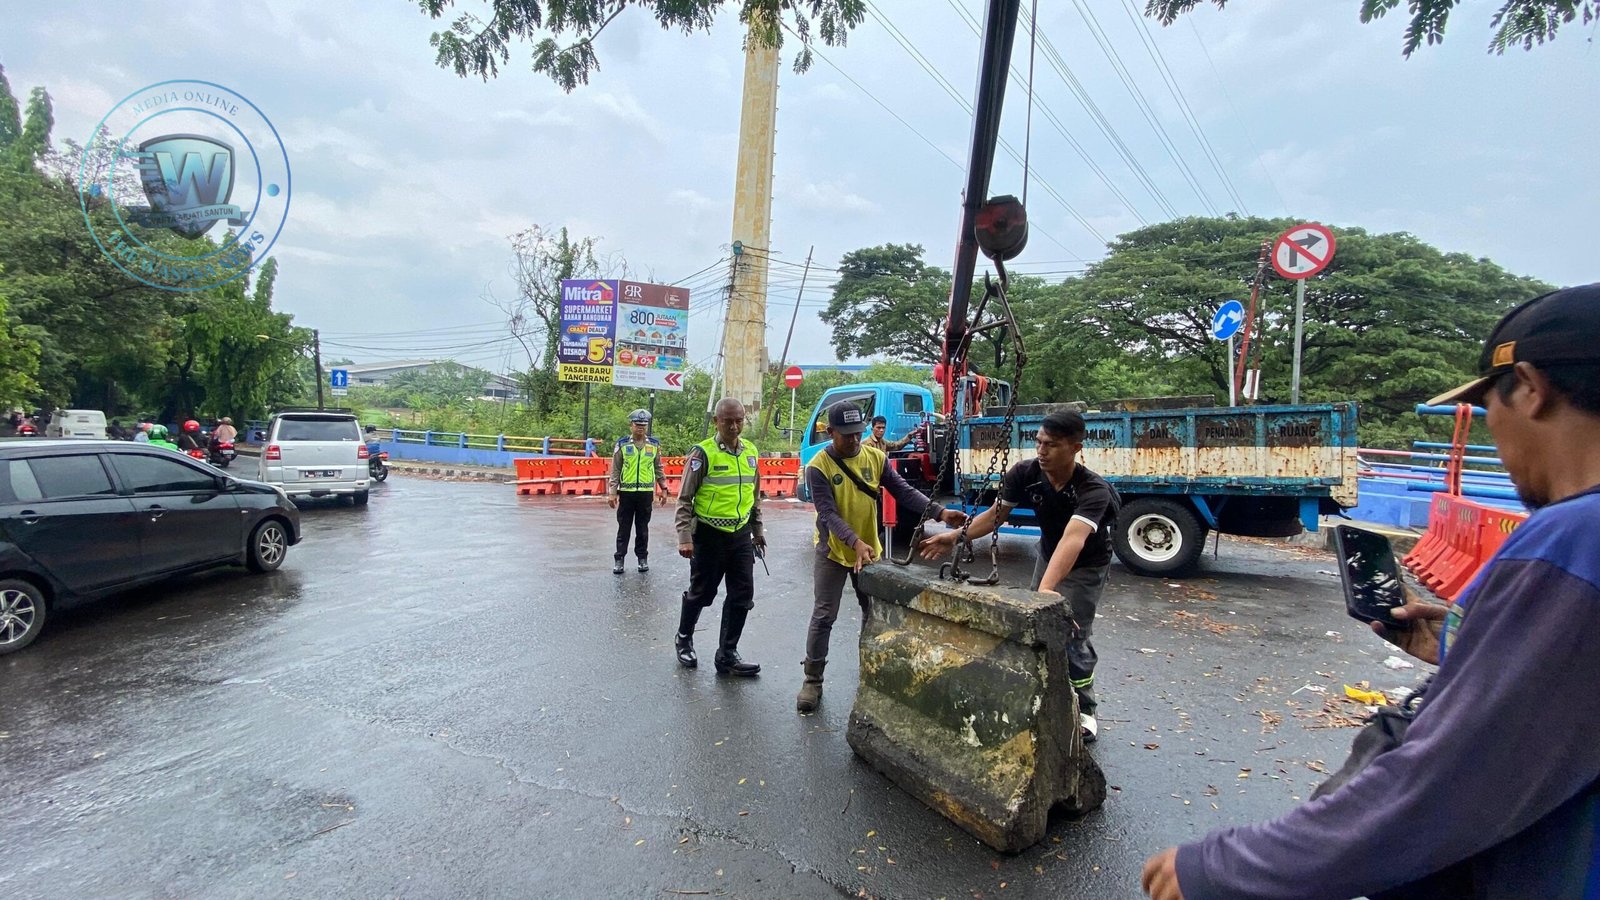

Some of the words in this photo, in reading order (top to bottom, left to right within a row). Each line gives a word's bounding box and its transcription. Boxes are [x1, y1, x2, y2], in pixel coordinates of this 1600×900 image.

[564, 304, 613, 314] SUPERMARKET
[630, 310, 655, 325] 800
[563, 366, 588, 374] PASAR
[589, 367, 611, 375] BARU
[564, 373, 610, 383] TANGERANG
[980, 430, 1001, 441] DINAS
[1149, 427, 1169, 440] DAN
[1205, 427, 1246, 439] PENATAAN
[1280, 425, 1316, 438] RUANG
